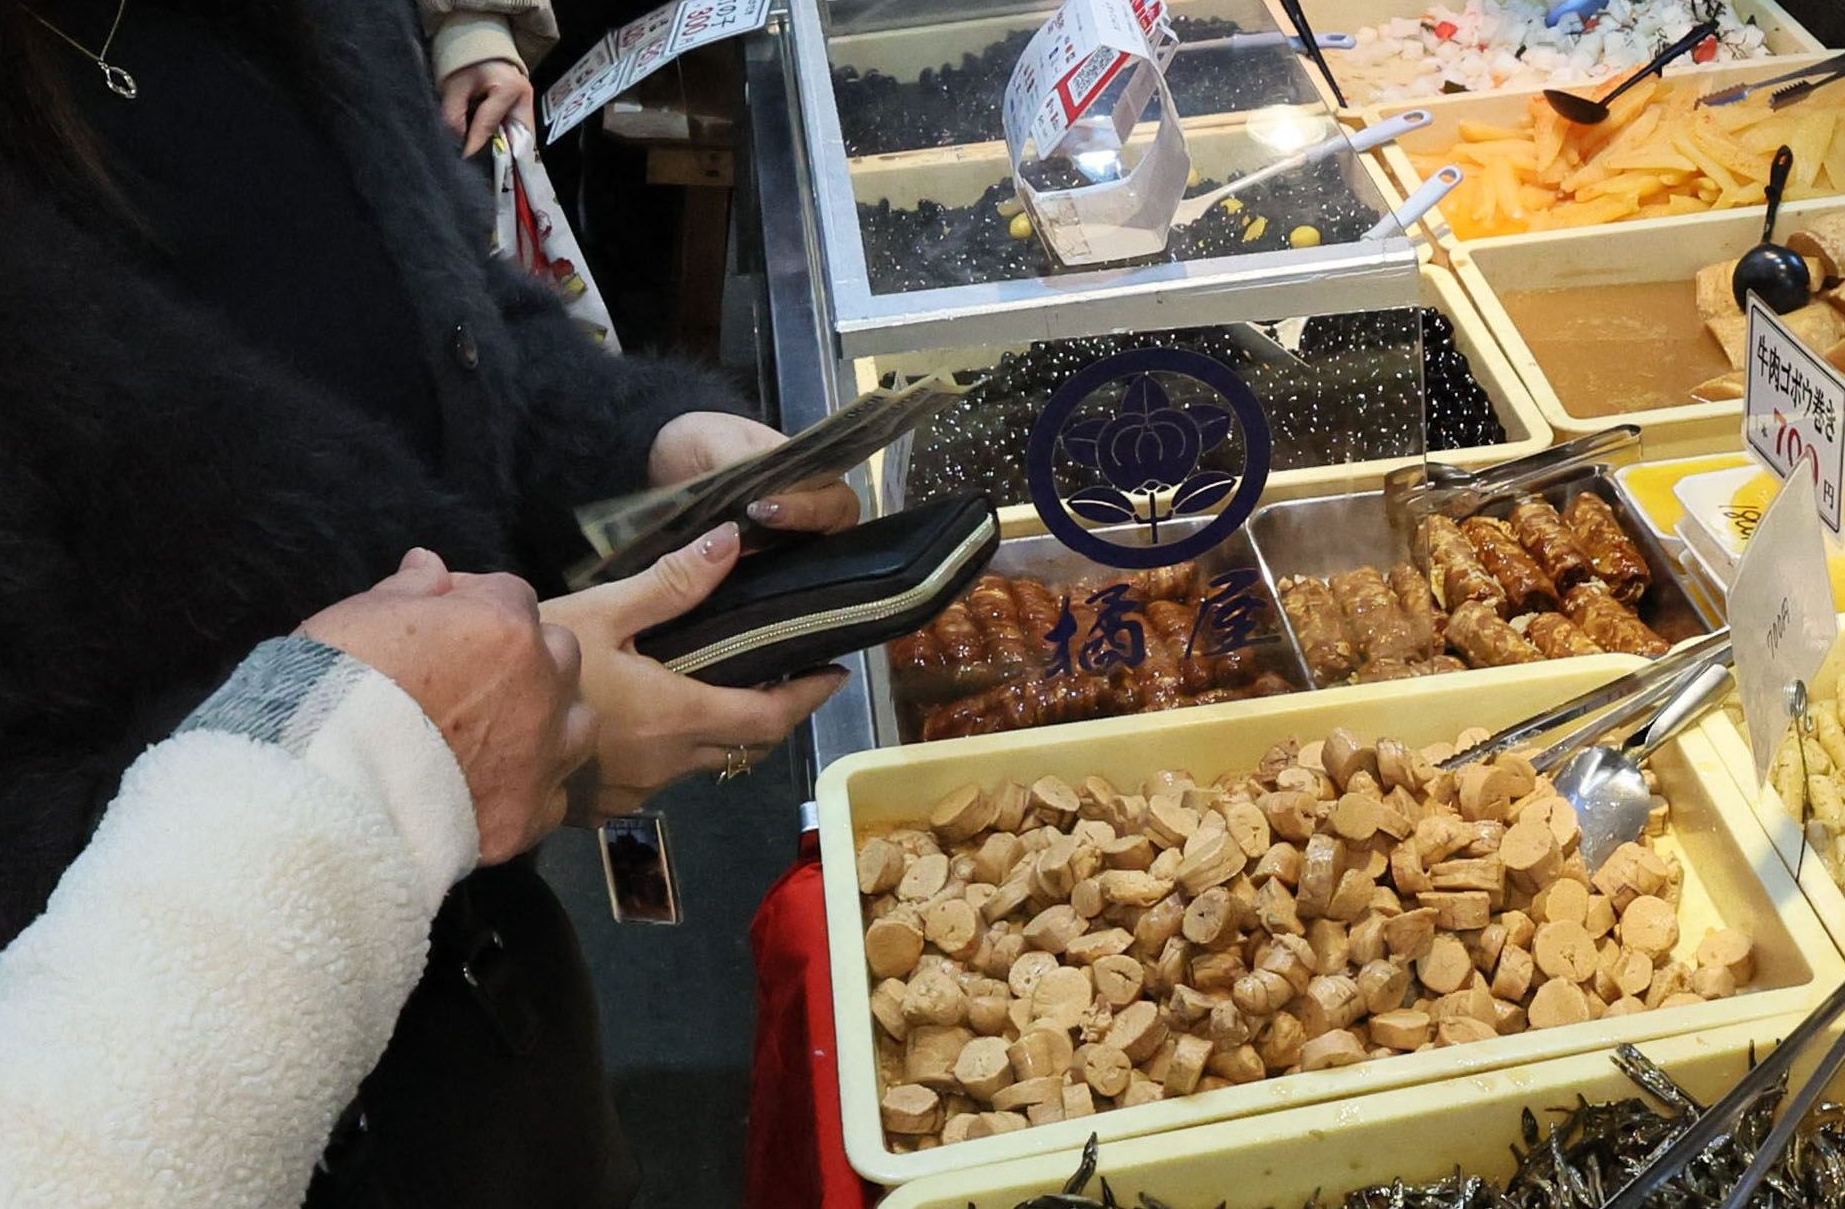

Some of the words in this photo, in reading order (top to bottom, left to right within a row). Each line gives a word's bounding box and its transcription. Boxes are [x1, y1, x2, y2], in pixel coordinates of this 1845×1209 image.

[1757, 334, 1837, 443] 牛肉ゴボウ巻き
[1042, 566, 1282, 678] 橘屋
